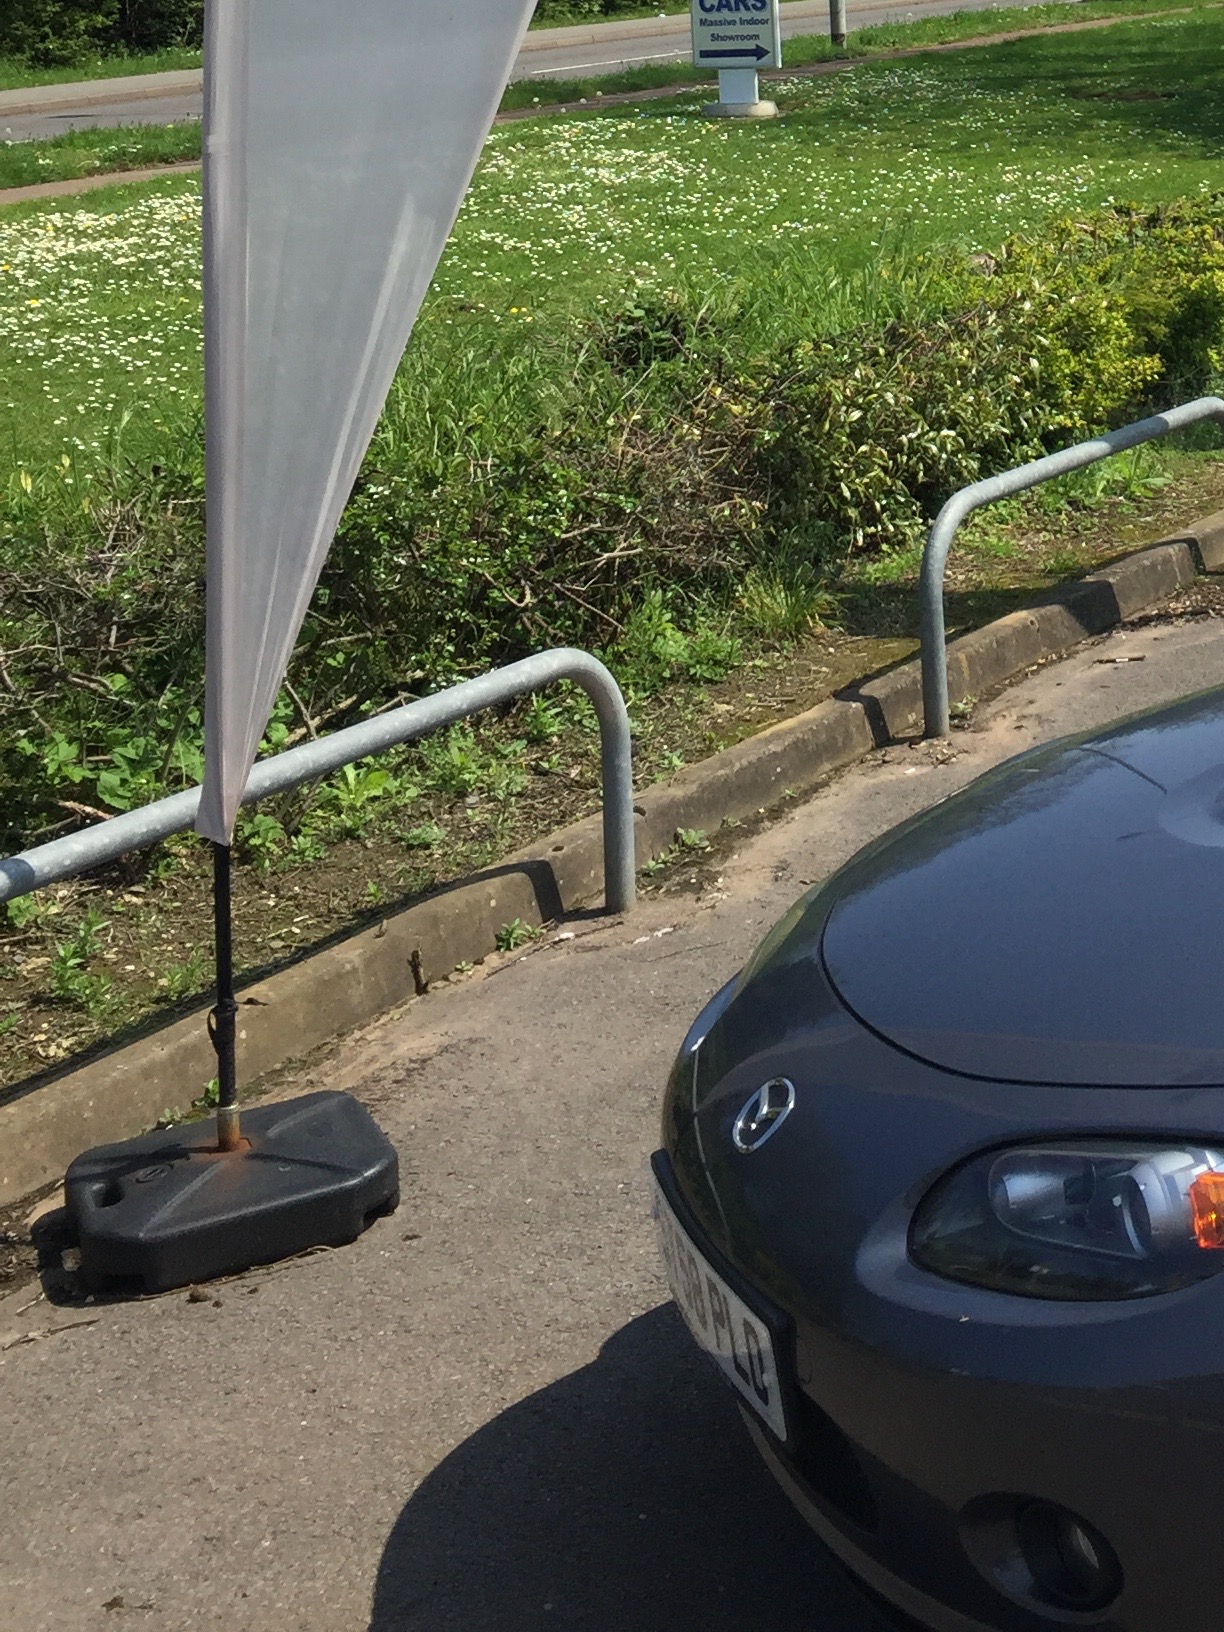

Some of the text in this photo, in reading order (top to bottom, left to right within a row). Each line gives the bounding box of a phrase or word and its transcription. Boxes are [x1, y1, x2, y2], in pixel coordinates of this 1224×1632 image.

[700, 17, 770, 27] Massive Indoor
[710, 33, 760, 42] Showroom
